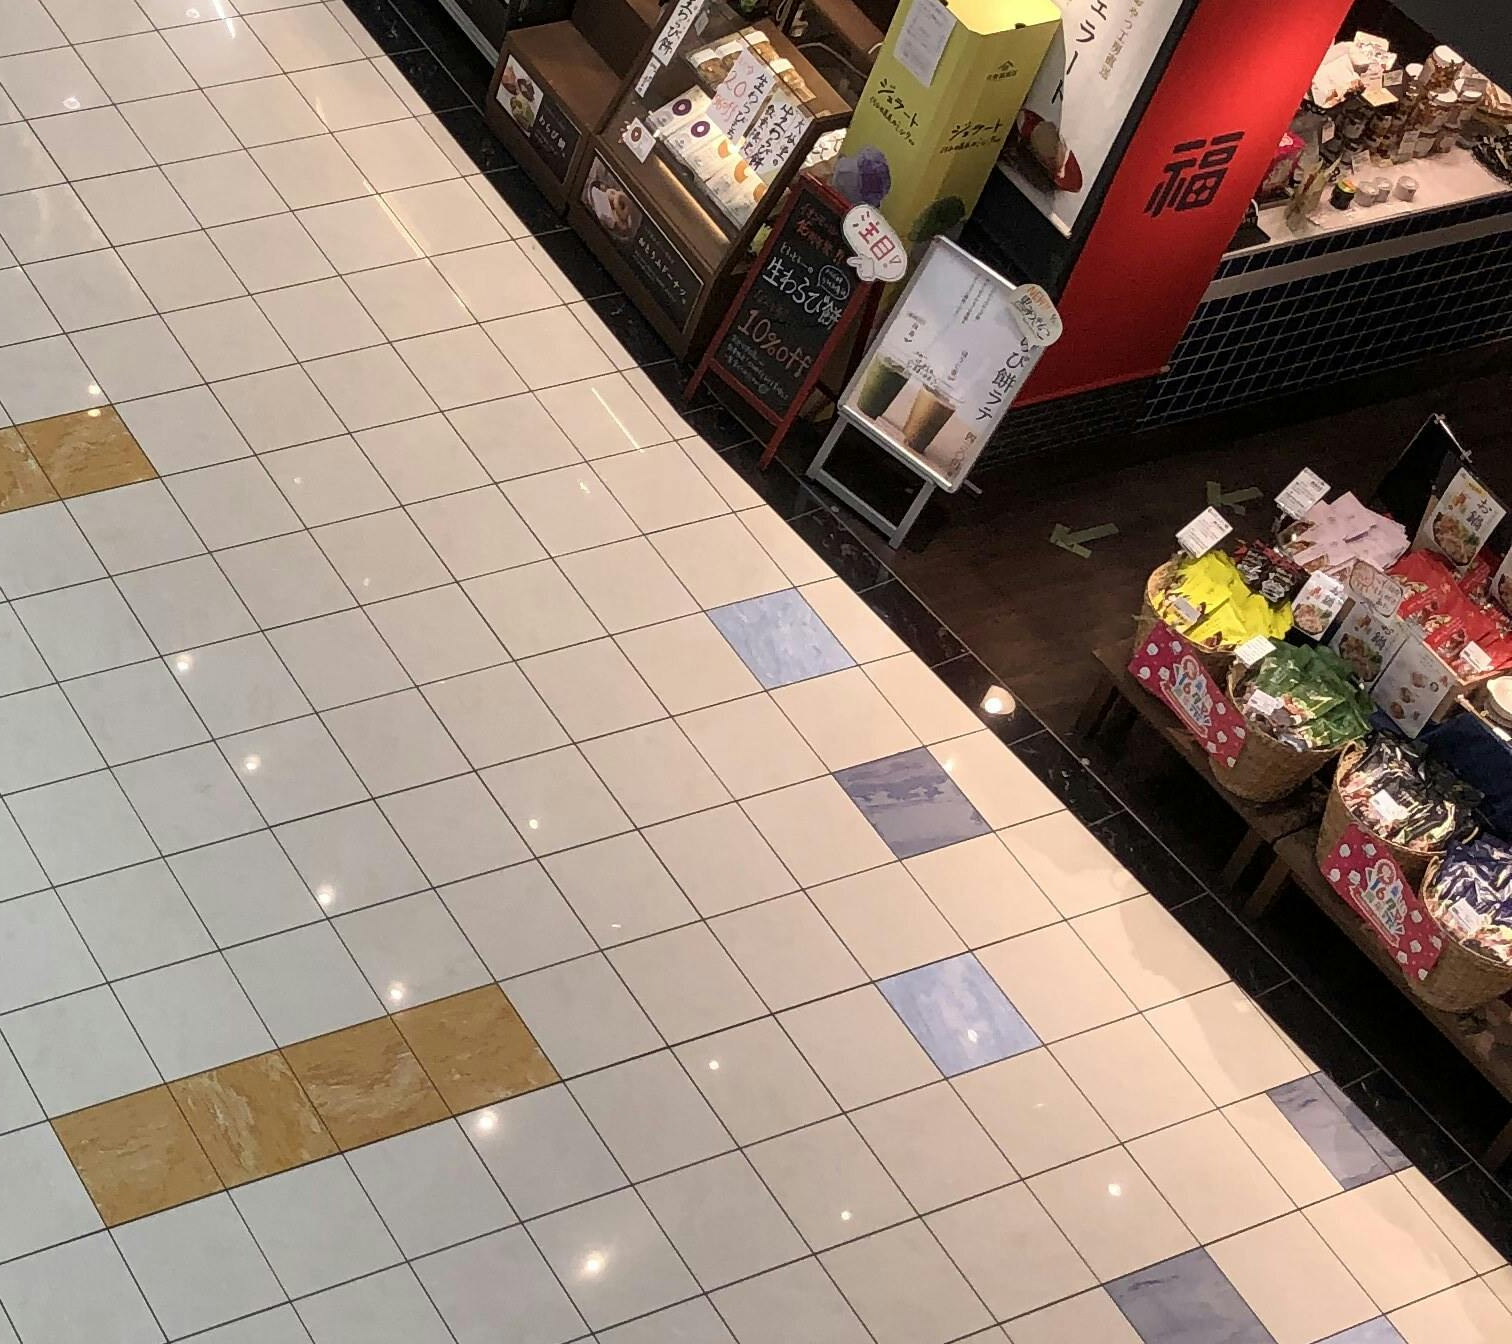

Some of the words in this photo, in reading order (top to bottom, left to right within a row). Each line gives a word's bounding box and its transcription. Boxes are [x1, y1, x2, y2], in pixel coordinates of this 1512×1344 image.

[1143, 131, 1245, 218] 福
[762, 255, 843, 332] 生わらび餅
[737, 309, 814, 379] 10%off
